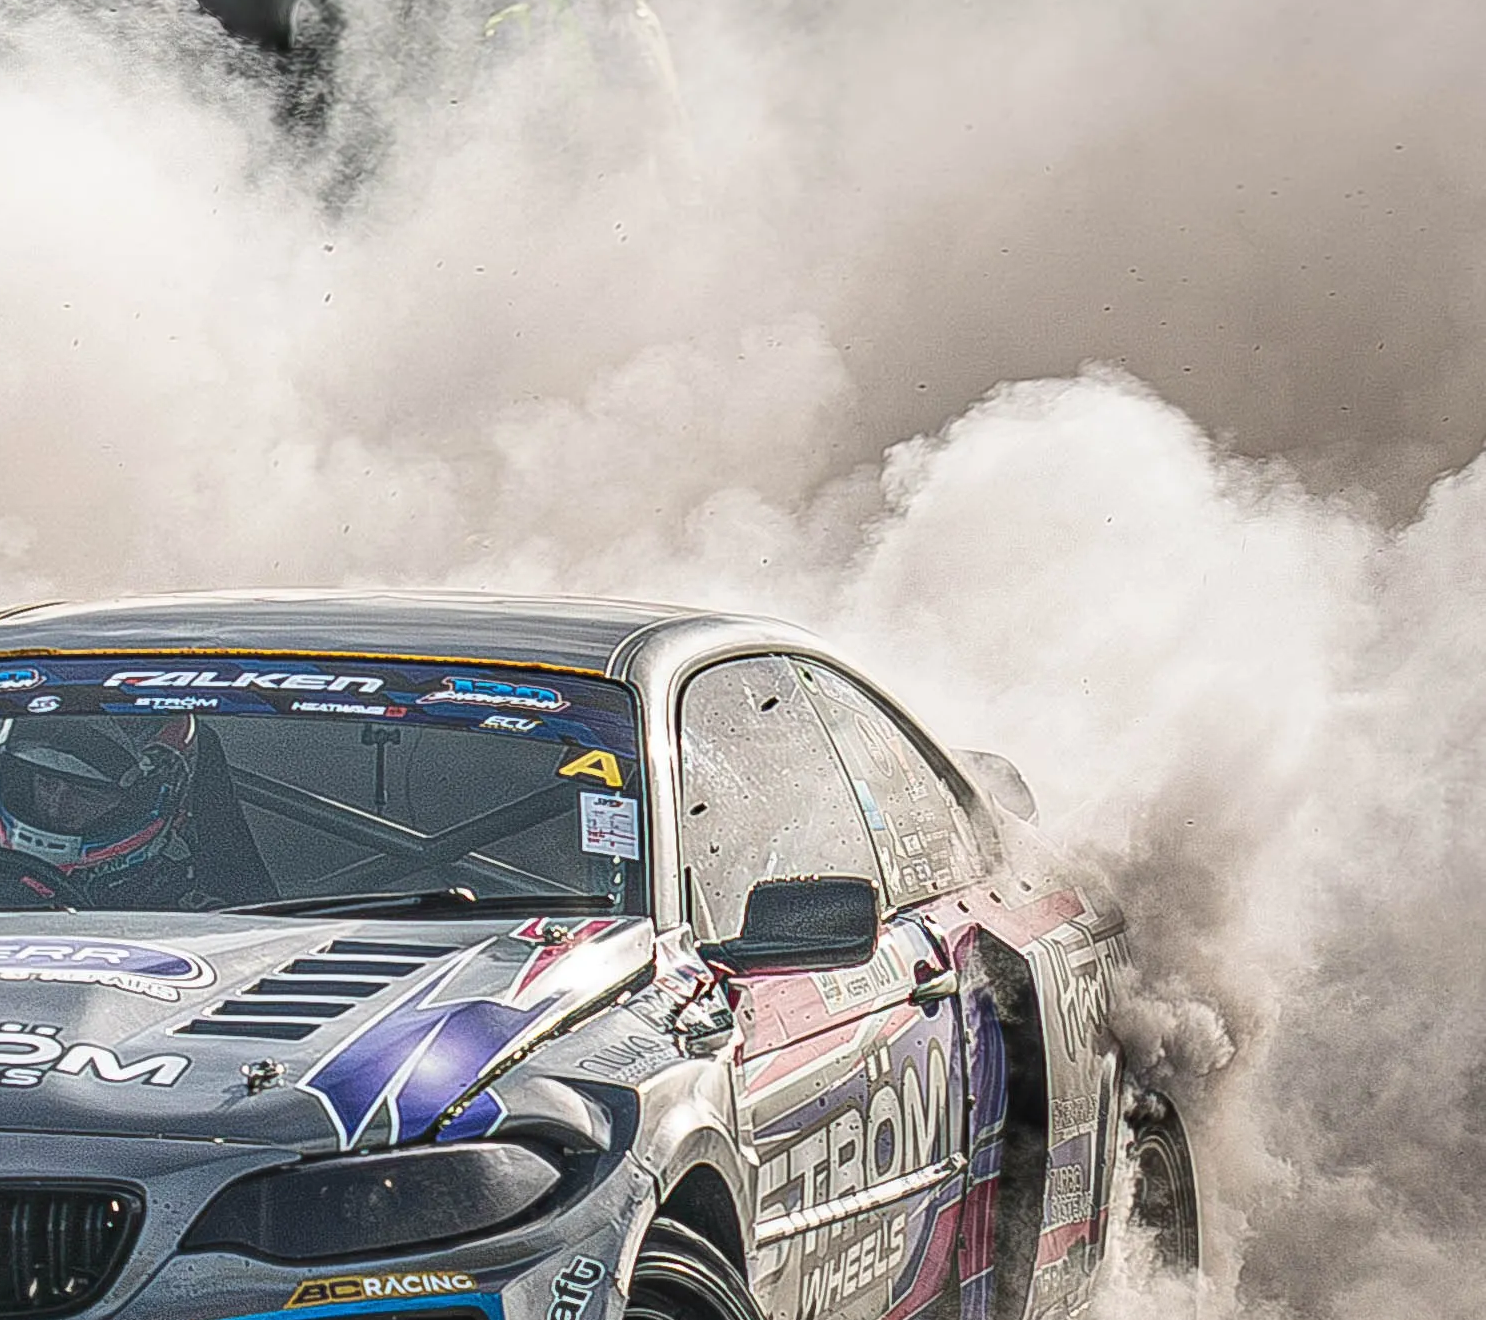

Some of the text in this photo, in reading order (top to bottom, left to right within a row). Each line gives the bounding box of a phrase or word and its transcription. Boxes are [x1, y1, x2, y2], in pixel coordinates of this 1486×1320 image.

[103, 671, 385, 693] FALKEN
[559, 750, 623, 786] A
[755, 1045, 949, 1283] STRÖM
[802, 1212, 907, 1320] WHEELS
[363, 1274, 473, 1297] RACING
